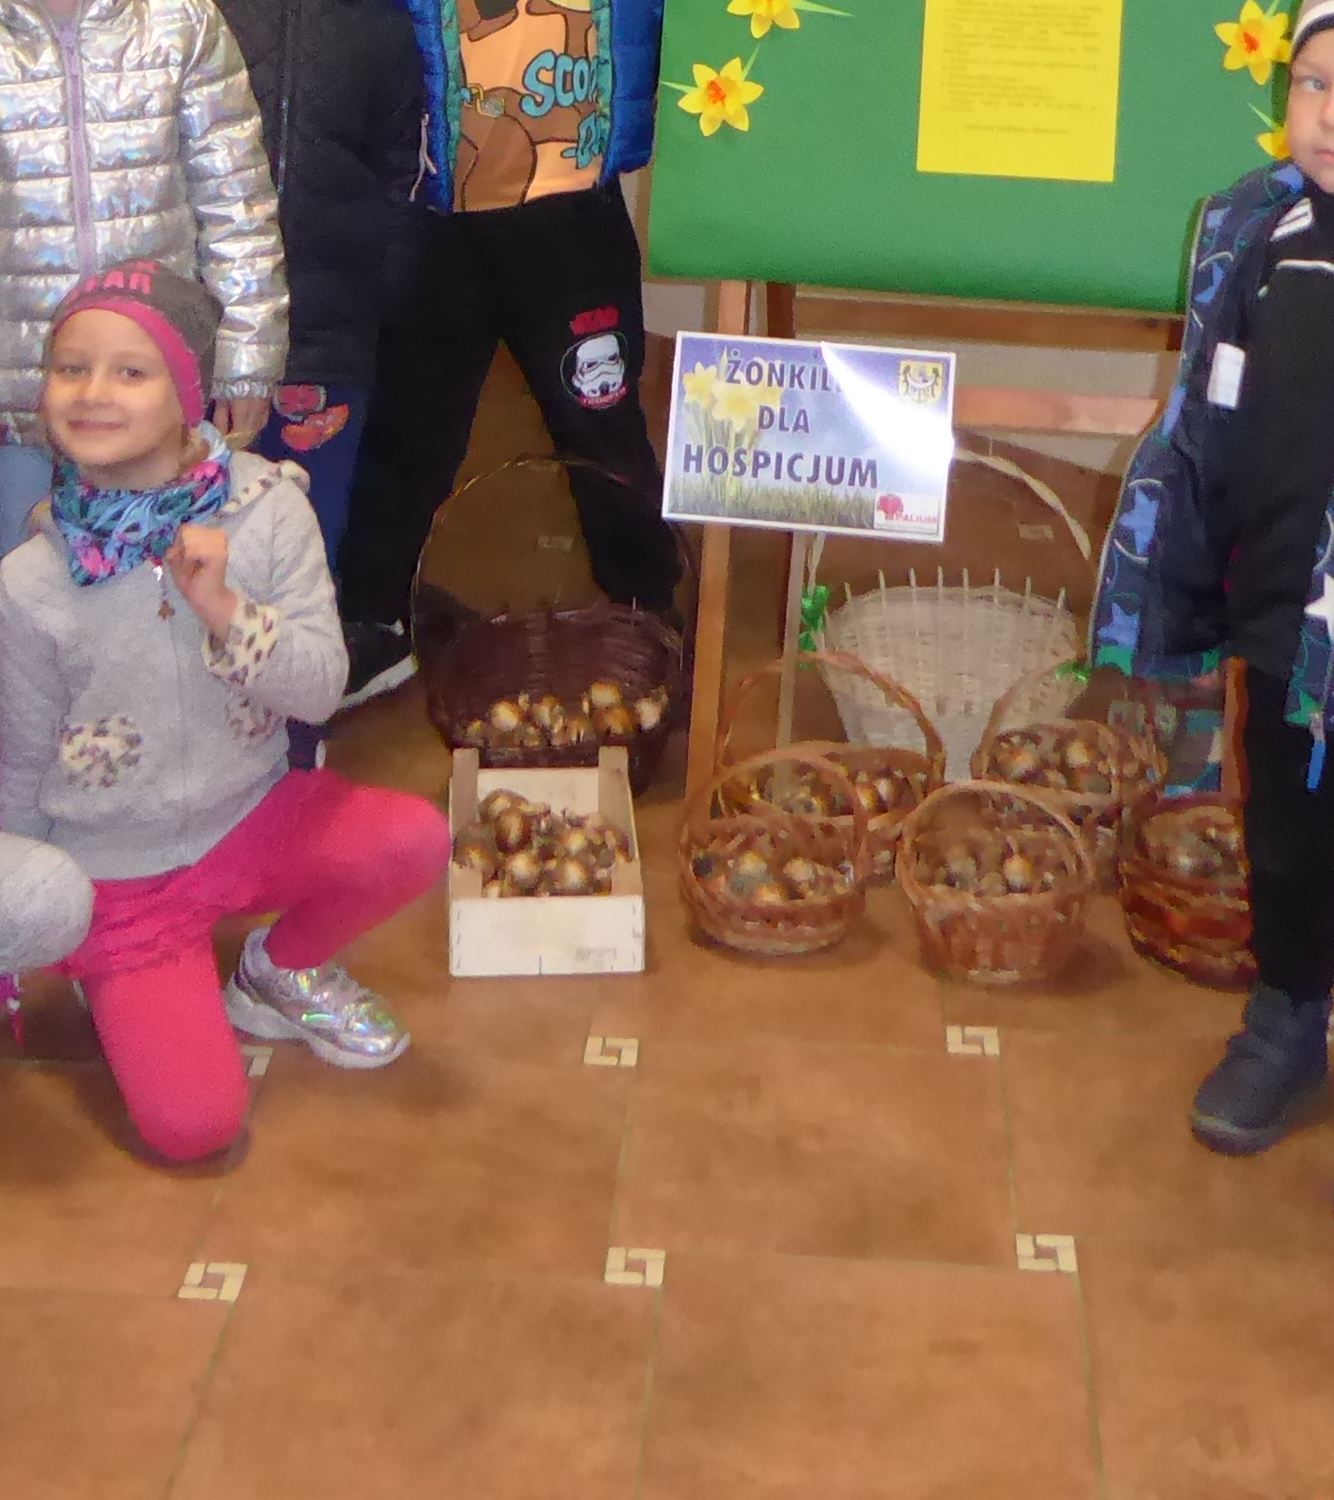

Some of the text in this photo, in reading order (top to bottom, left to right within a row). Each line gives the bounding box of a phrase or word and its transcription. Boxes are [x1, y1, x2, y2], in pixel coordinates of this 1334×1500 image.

[725, 348, 843, 394] ŻONKIL
[757, 405, 810, 434] DLA
[682, 444, 878, 489] HOSPICJUM
